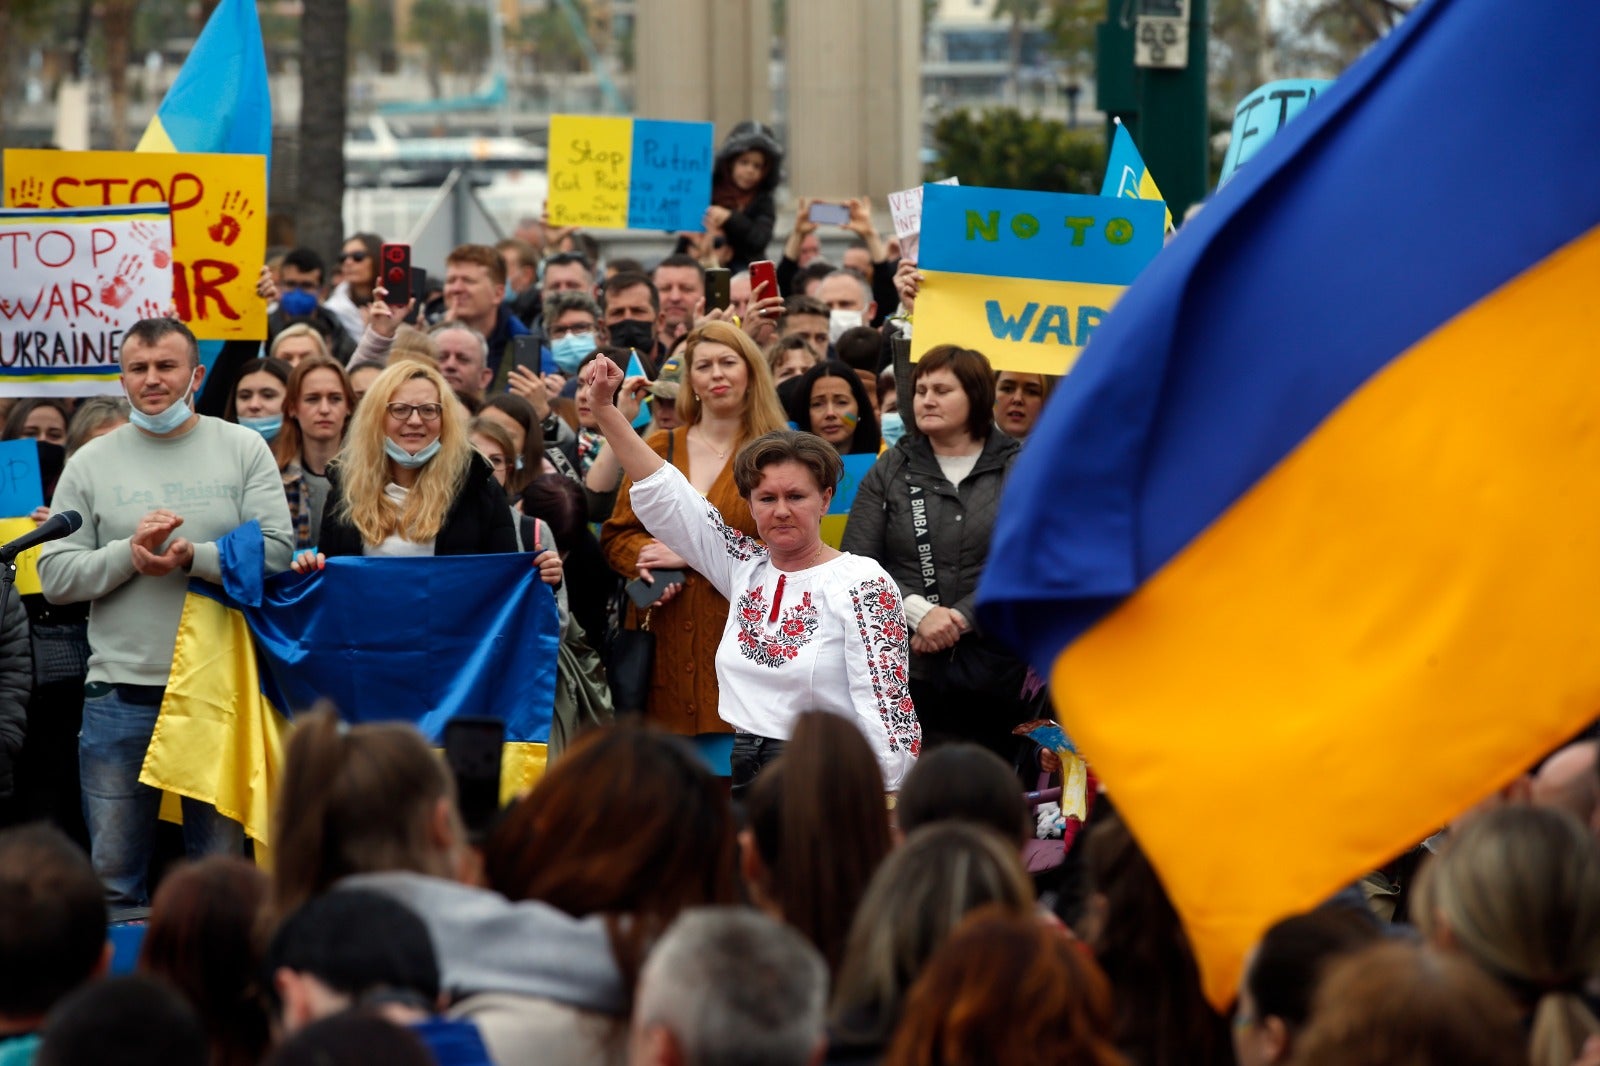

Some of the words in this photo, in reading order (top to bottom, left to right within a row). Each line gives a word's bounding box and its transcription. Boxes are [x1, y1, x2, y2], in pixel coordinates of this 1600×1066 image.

[568, 139, 625, 174] Stop
[965, 209, 1040, 242] NO
[1064, 216, 1134, 246] TO
[911, 499, 928, 537] BIMBA
[918, 543, 936, 588] BIMBA
